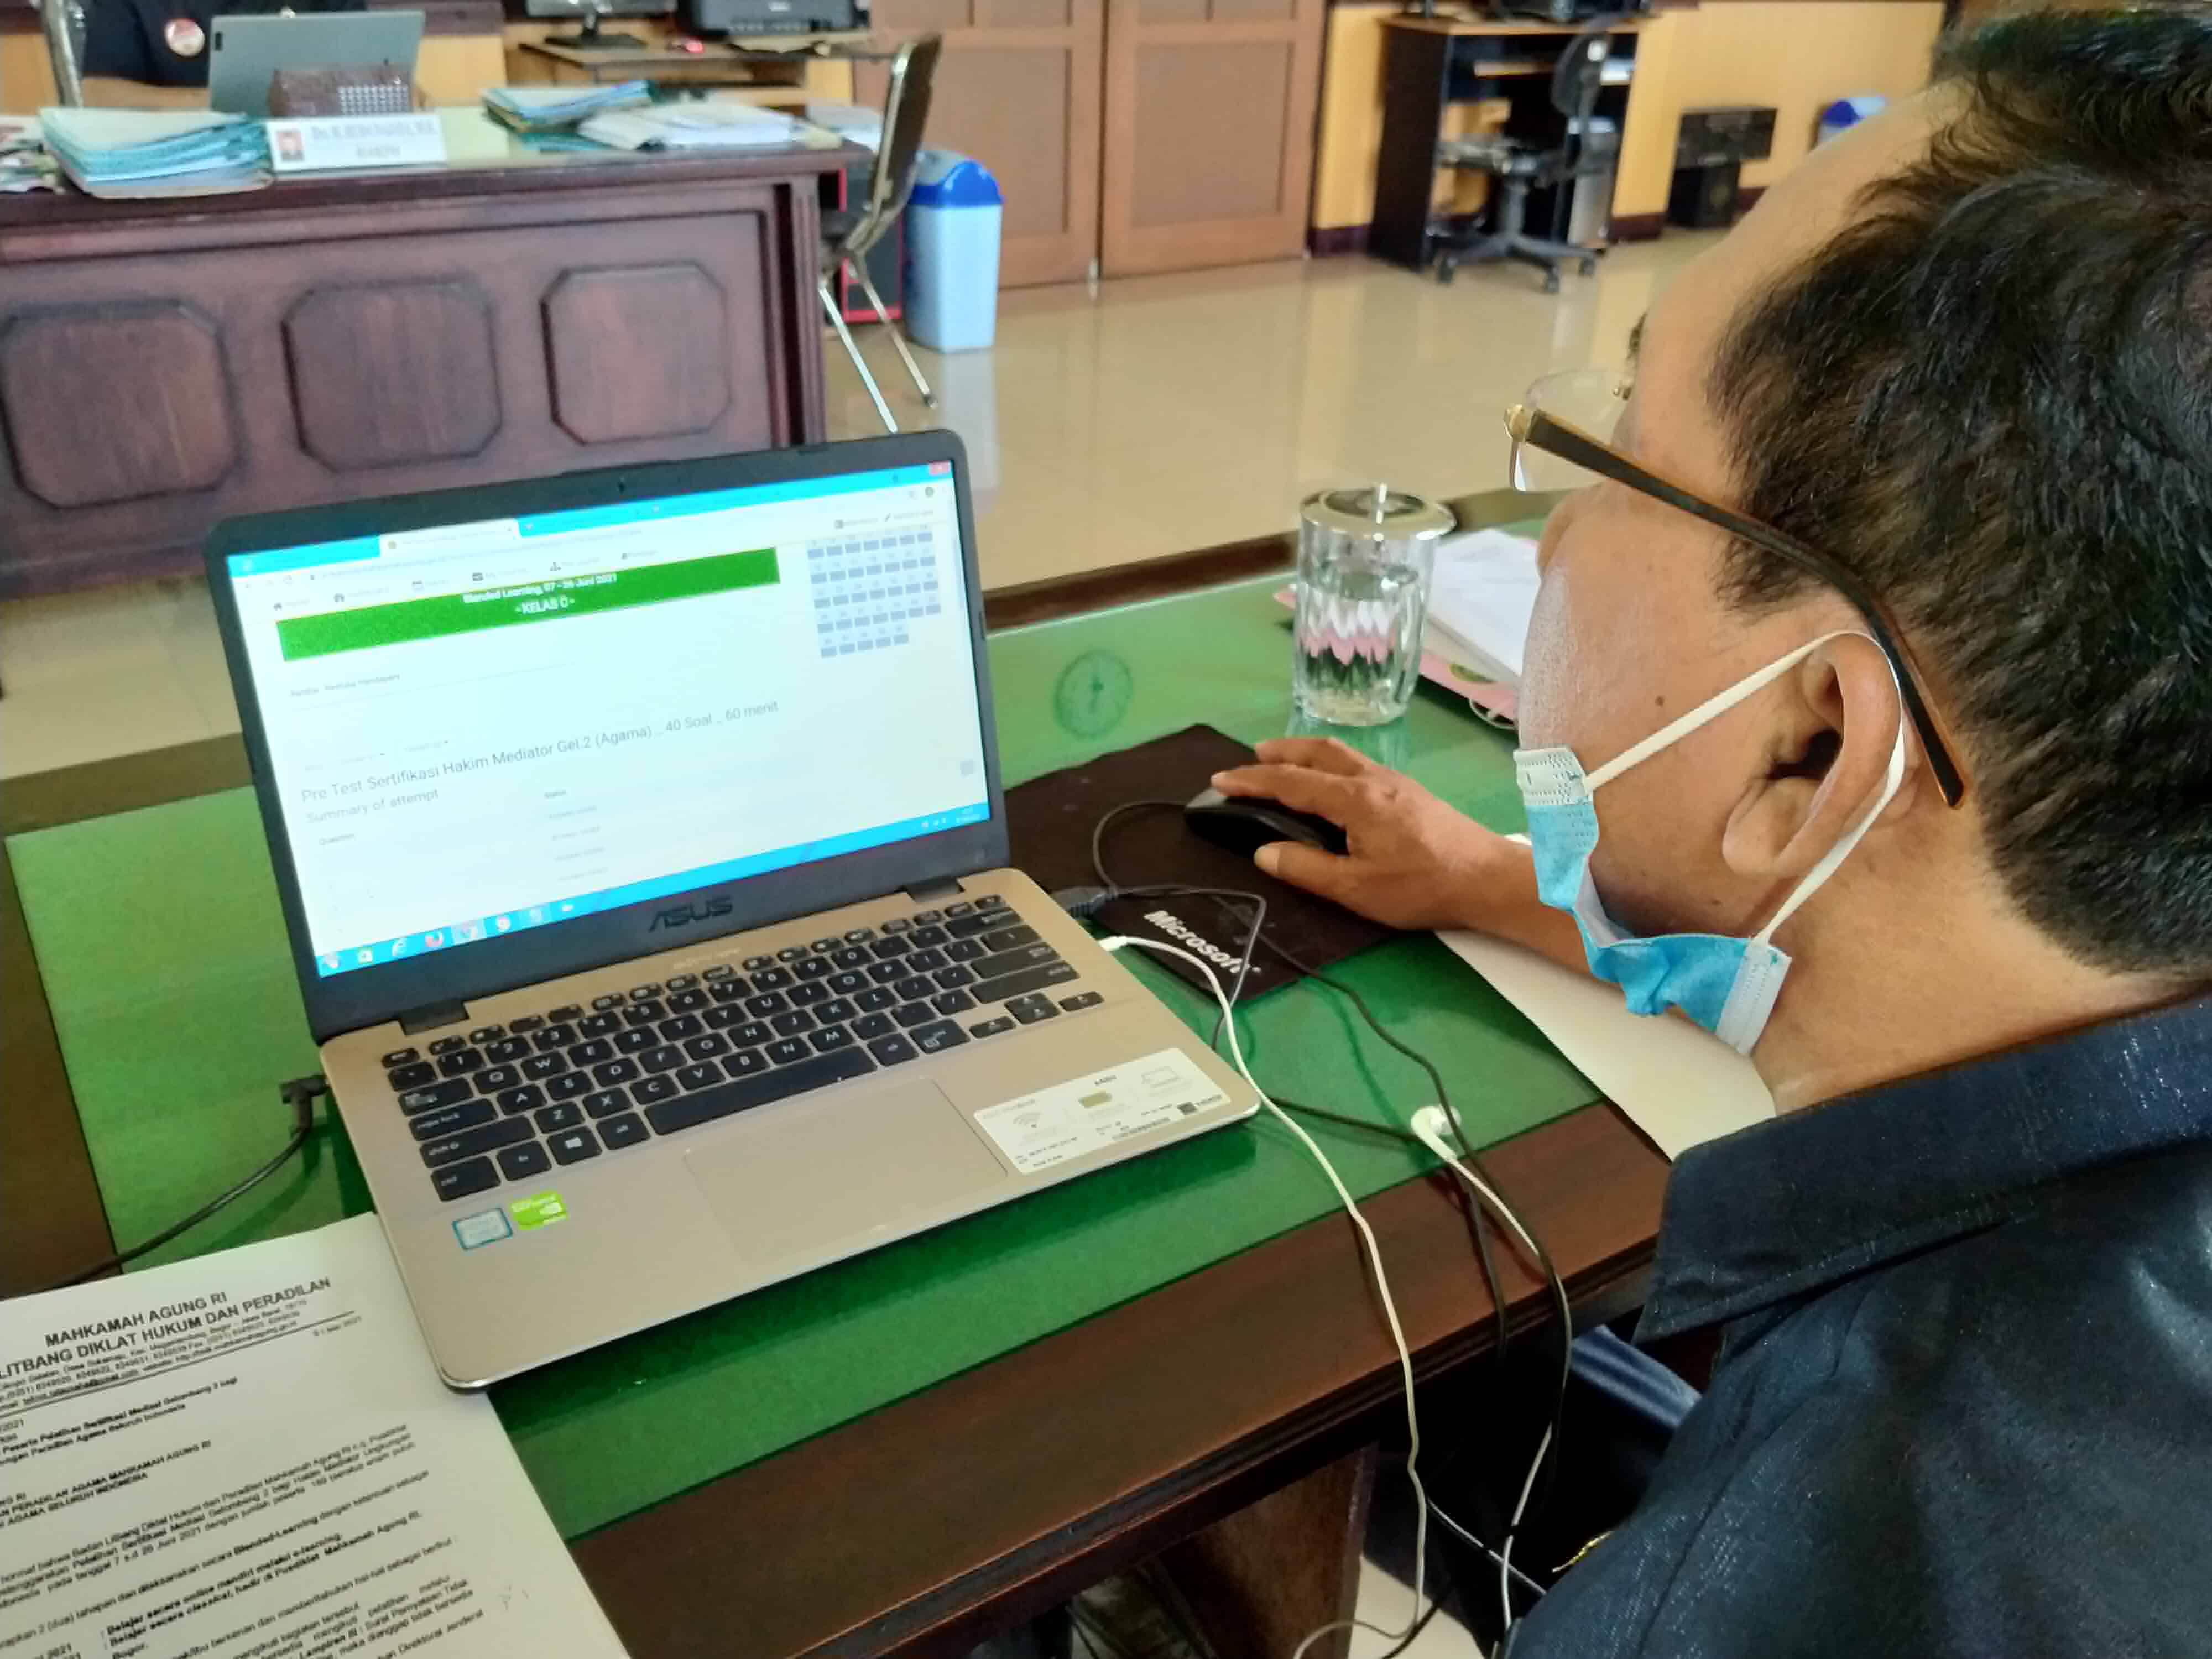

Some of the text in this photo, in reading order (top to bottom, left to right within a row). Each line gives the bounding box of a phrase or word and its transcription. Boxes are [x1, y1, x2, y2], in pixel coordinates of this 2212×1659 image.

[301, 788, 328, 804] Pre
[331, 780, 363, 797] Test
[367, 765, 440, 790] Sertifikasi
[442, 754, 489, 776] Hakim
[492, 743, 554, 766] Mediator
[665, 718, 682, 734] 40
[684, 712, 713, 730] Soal
[724, 707, 742, 722] 60
[744, 700, 779, 718] menit
[306, 789, 440, 825] Summary of attempt
[648, 894, 734, 933] ASUS
[44, 1291, 227, 1347] MAHKAMAH AGUNG RI
[77, 1332, 137, 1358] DIKLAT
[142, 1316, 202, 1342] HUKUM
[205, 1304, 239, 1324] DAN
[242, 1276, 331, 1312] PERADILAN
